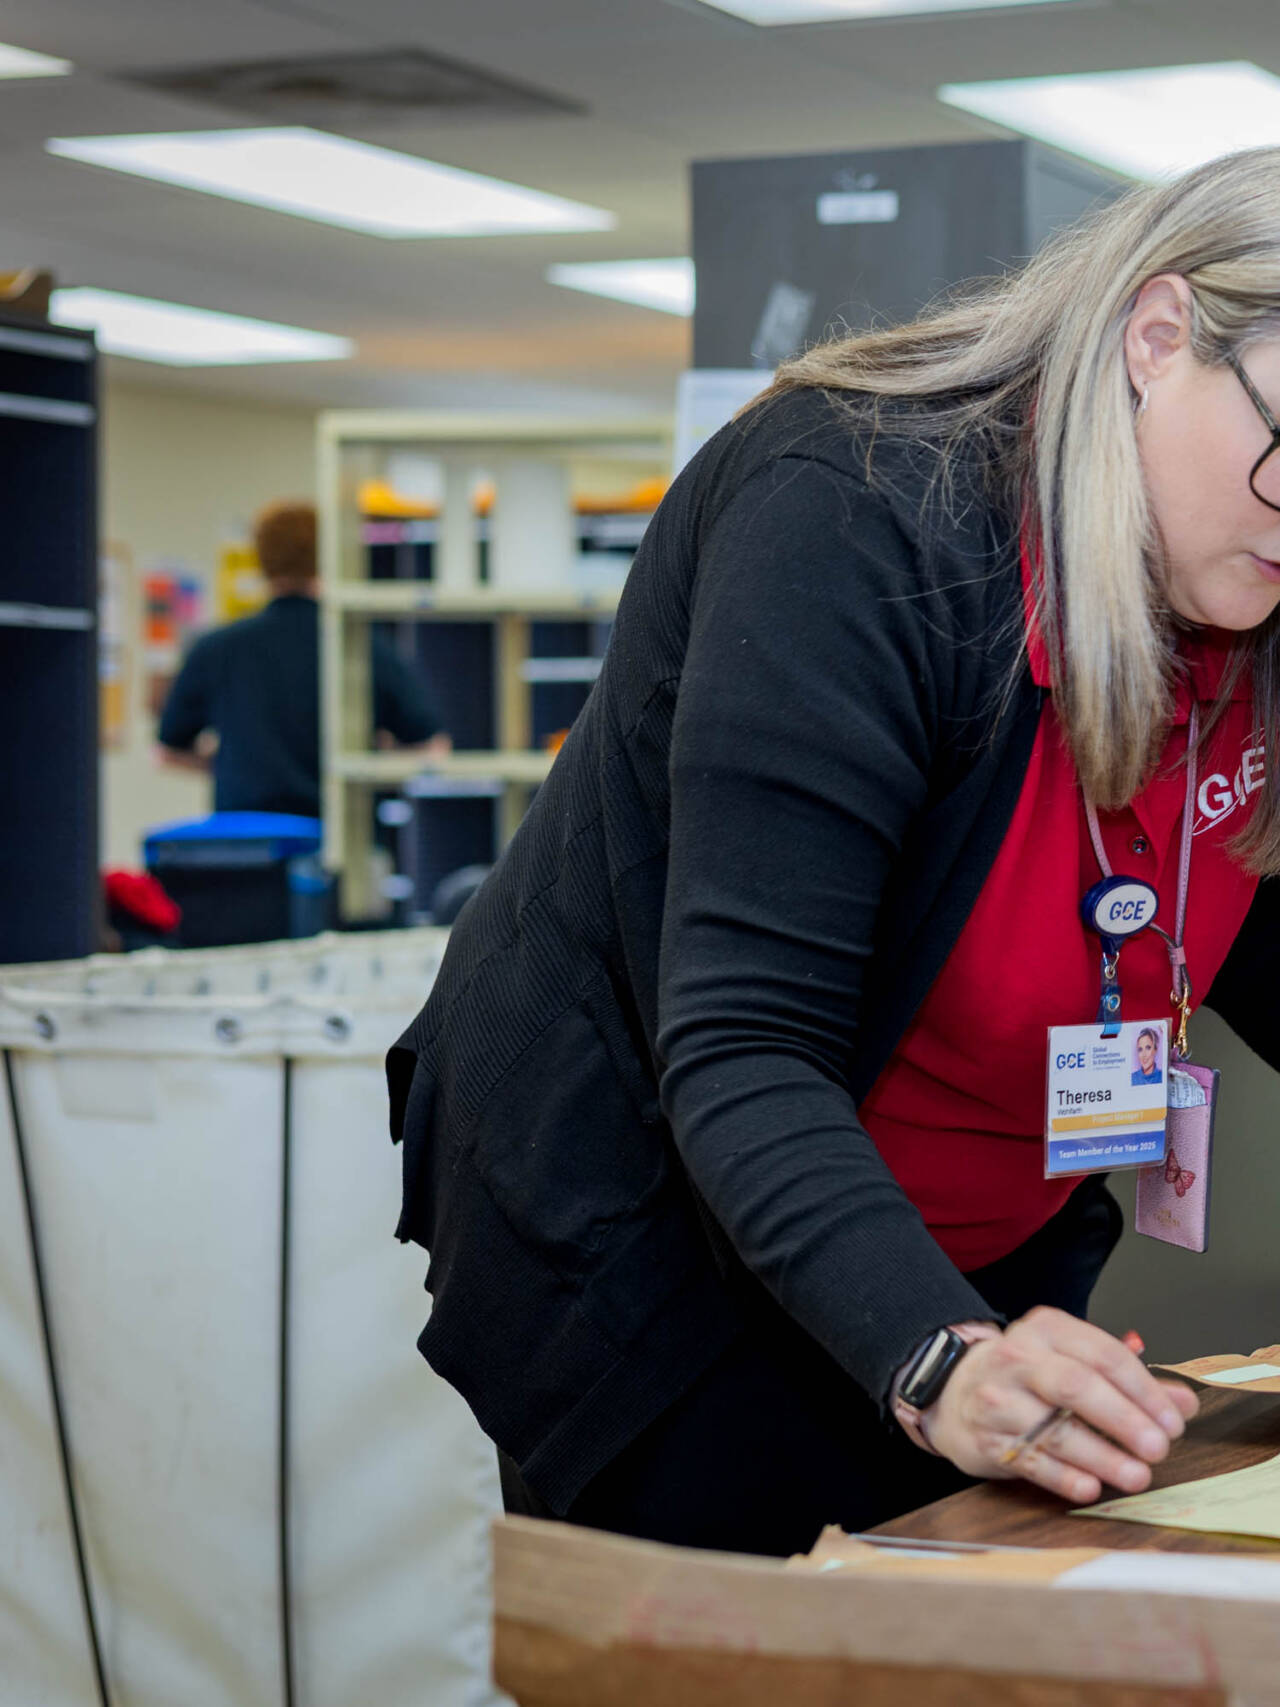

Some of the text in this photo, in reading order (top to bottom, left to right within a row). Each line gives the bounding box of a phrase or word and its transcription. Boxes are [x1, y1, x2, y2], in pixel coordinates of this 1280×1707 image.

[1109, 901, 1146, 921] GCE
[1056, 1052, 1086, 1070] GCE
[1057, 1089, 1112, 1106] Theresa
[1059, 1150, 1077, 1159] Team
[1078, 1147, 1104, 1157] Member
[1104, 1145, 1112, 1154] of
[1112, 1144, 1123, 1153] the
[1124, 1143, 1139, 1152] Year
